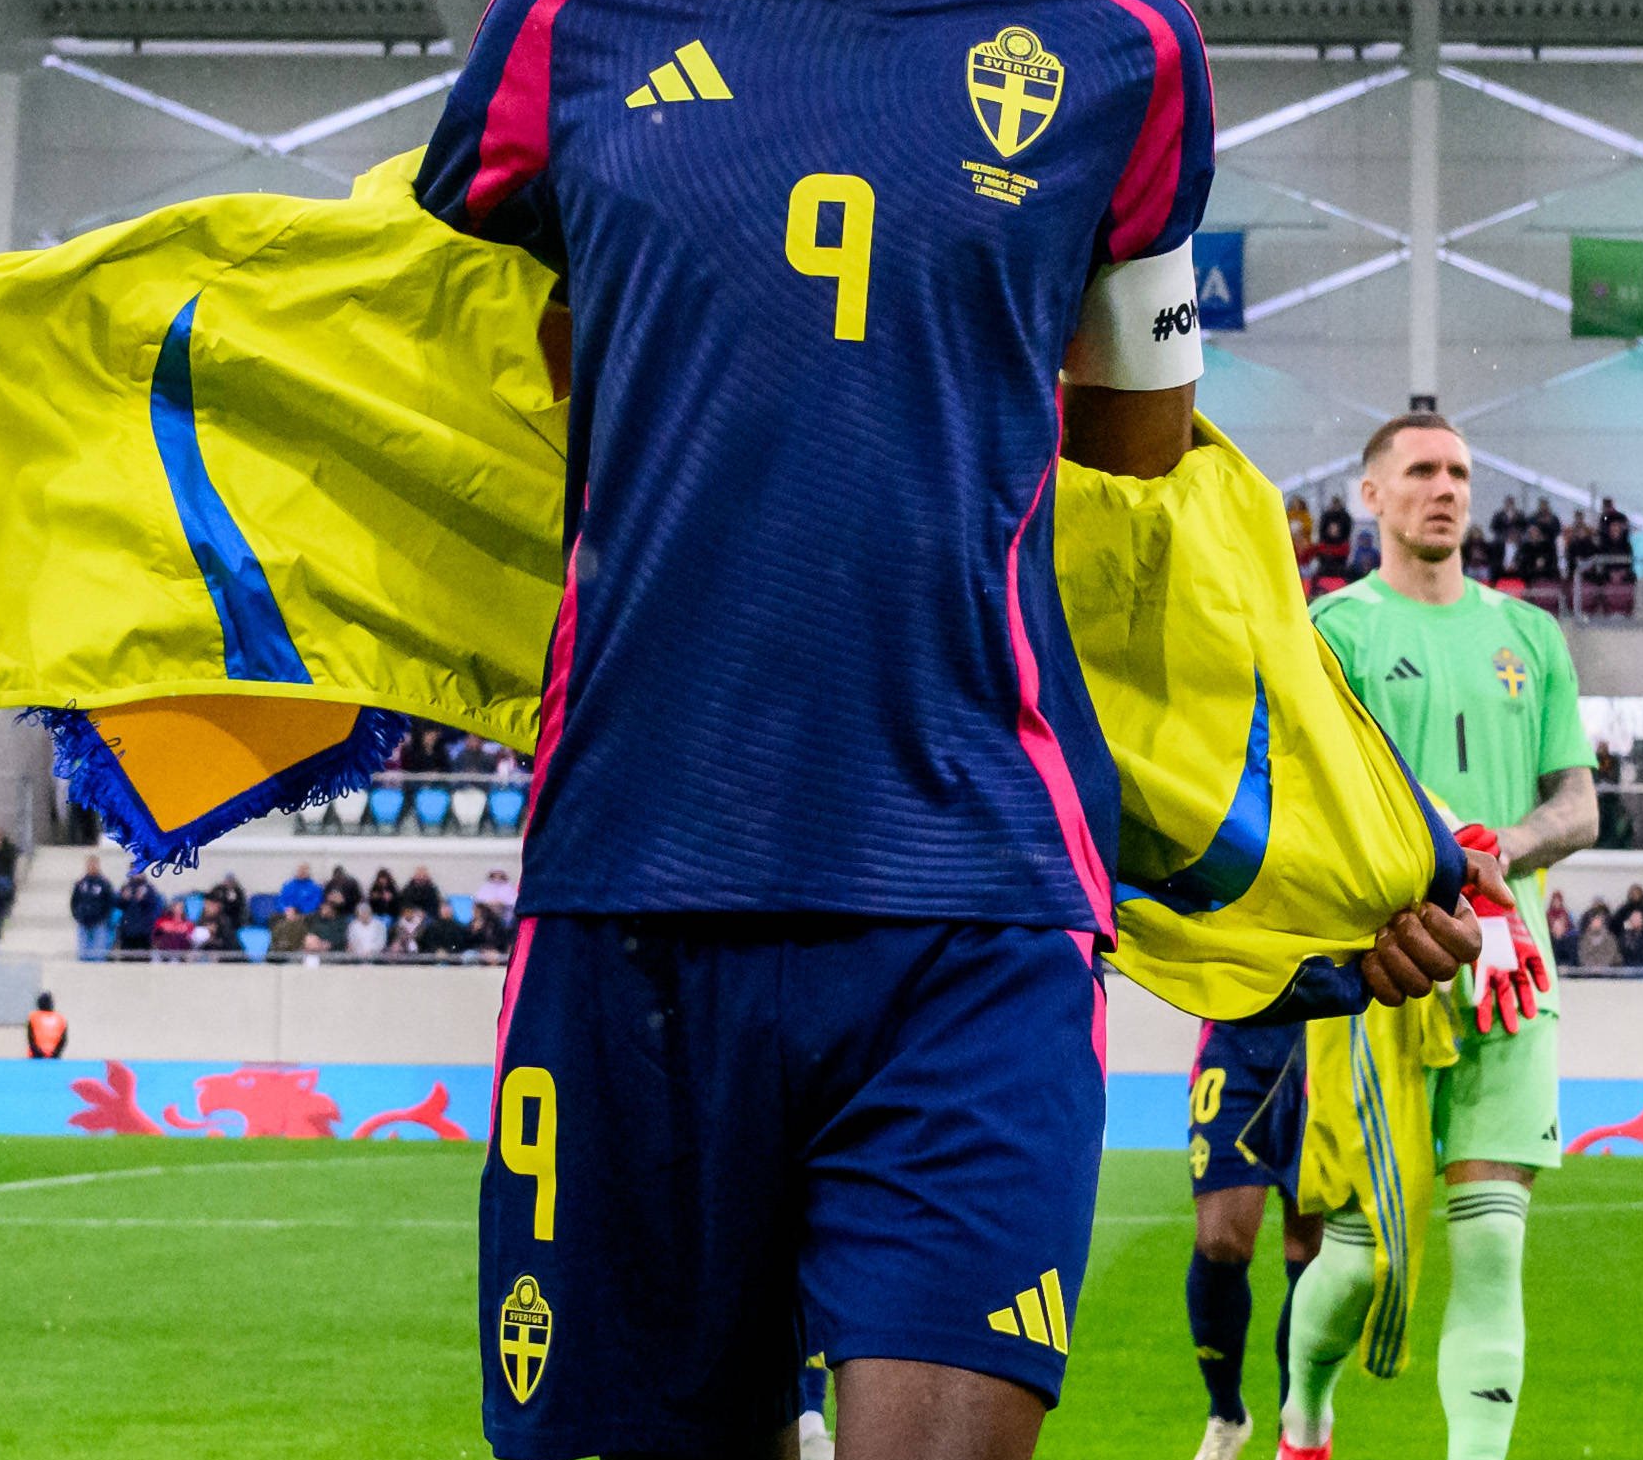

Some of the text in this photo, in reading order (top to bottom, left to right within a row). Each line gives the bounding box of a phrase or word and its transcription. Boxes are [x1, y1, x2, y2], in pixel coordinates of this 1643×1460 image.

[983, 57, 1049, 79] SVERIGE
[784, 172, 876, 342] 9
[1455, 712, 1468, 772] 1
[500, 1066, 558, 1241] 9
[509, 1311, 544, 1325] SVERIGE
